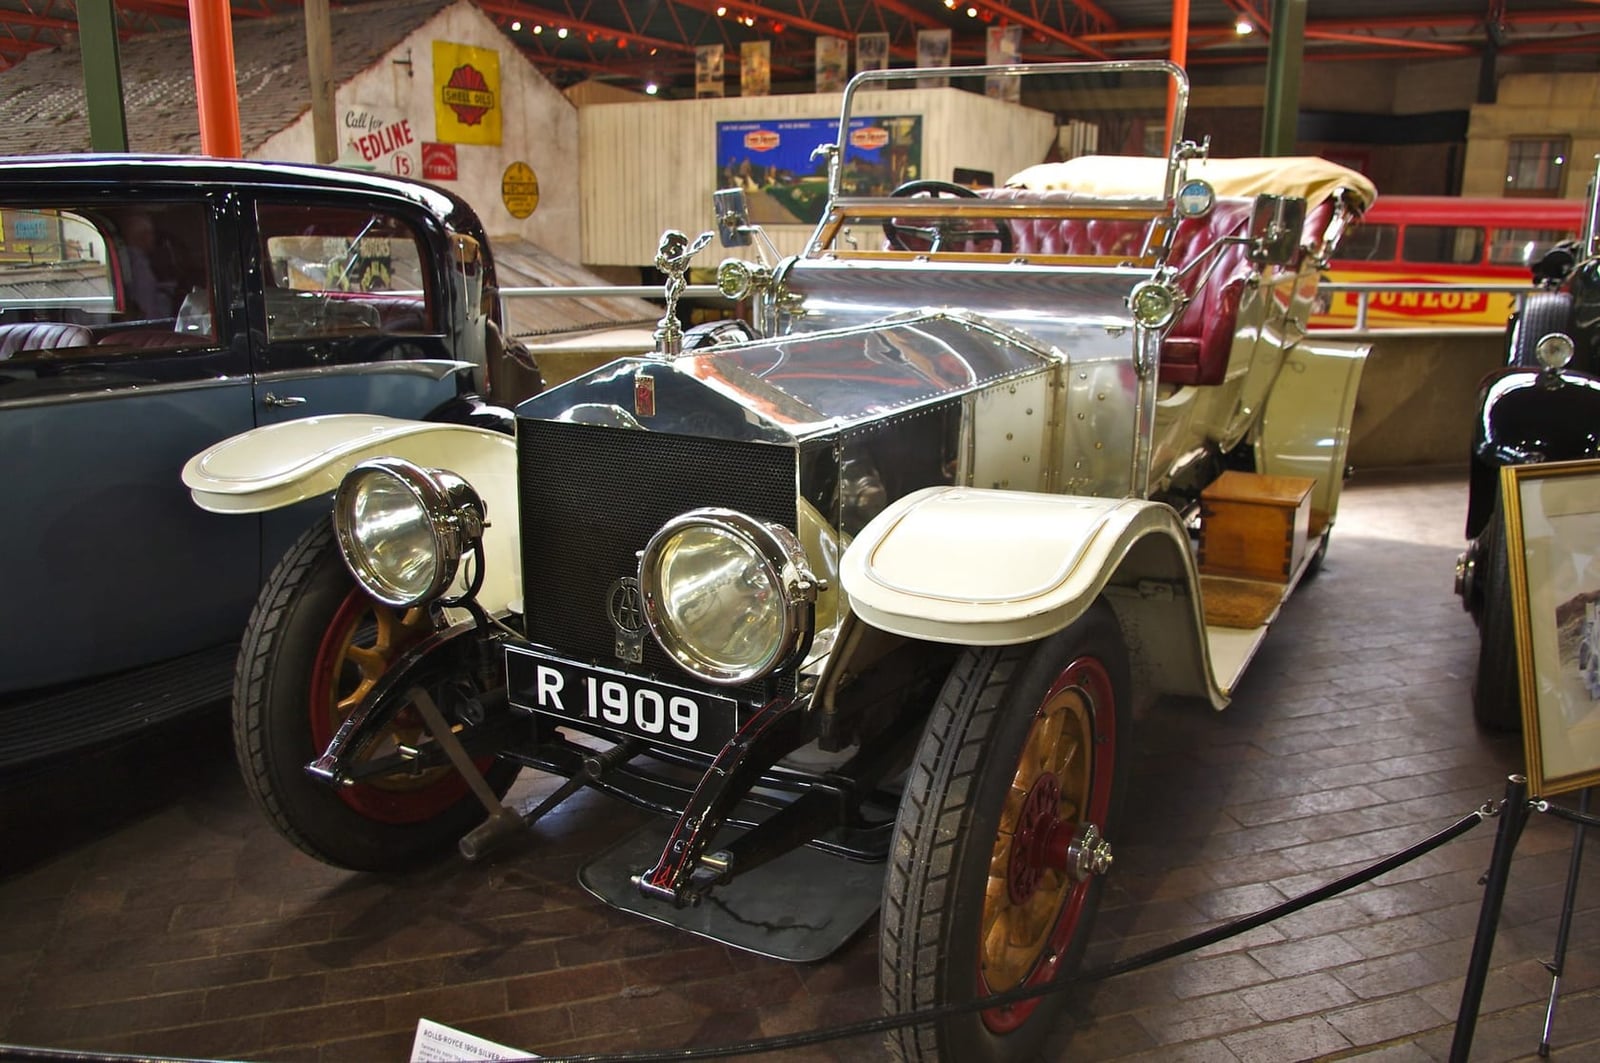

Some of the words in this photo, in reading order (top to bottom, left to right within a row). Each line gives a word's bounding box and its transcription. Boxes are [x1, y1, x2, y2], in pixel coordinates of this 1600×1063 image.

[446, 90, 470, 103] SHELL
[474, 93, 491, 105] OILS
[345, 111, 368, 128] Call
[368, 115, 383, 132] for
[536, 665, 565, 710] R
[587, 677, 699, 742] 1909
